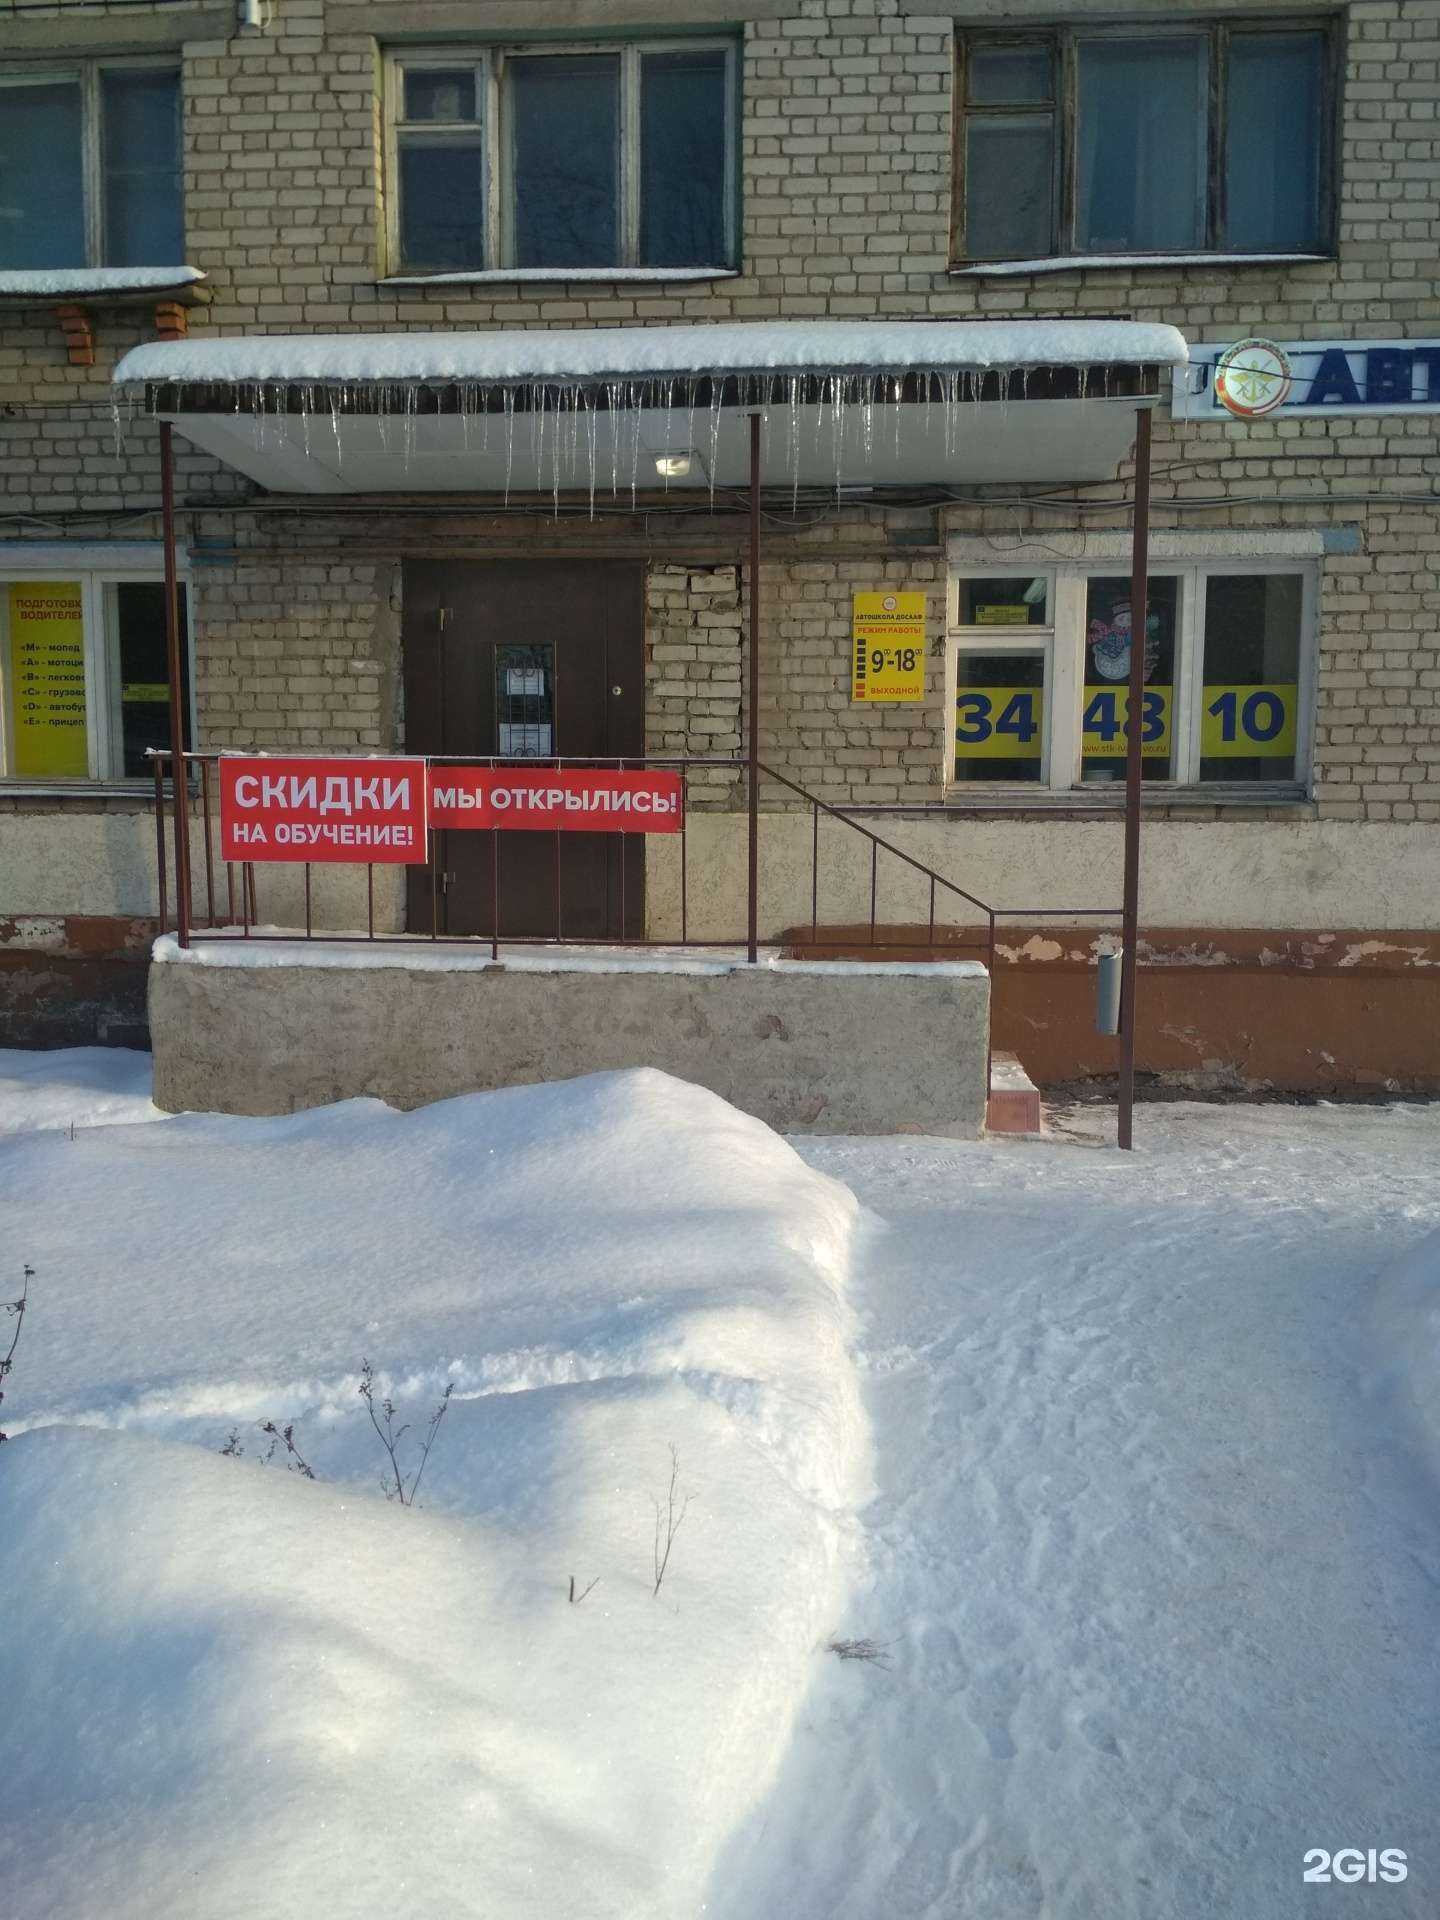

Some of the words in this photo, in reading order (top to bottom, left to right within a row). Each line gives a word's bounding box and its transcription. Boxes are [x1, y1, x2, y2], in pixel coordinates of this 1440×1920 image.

[871, 686, 919, 694] ВЫХОДНОЙ
[955, 694, 1038, 743] 34
[1083, 692, 1165, 742] 48
[1208, 691, 1285, 742] 10
[235, 775, 410, 816] СКИДКИ
[433, 788, 482, 809] МЫ
[490, 787, 677, 813] ОТКРЫЛИСЬ!
[233, 823, 267, 844] НА
[274, 823, 413, 846] ОБУЧЕНИЕ!
